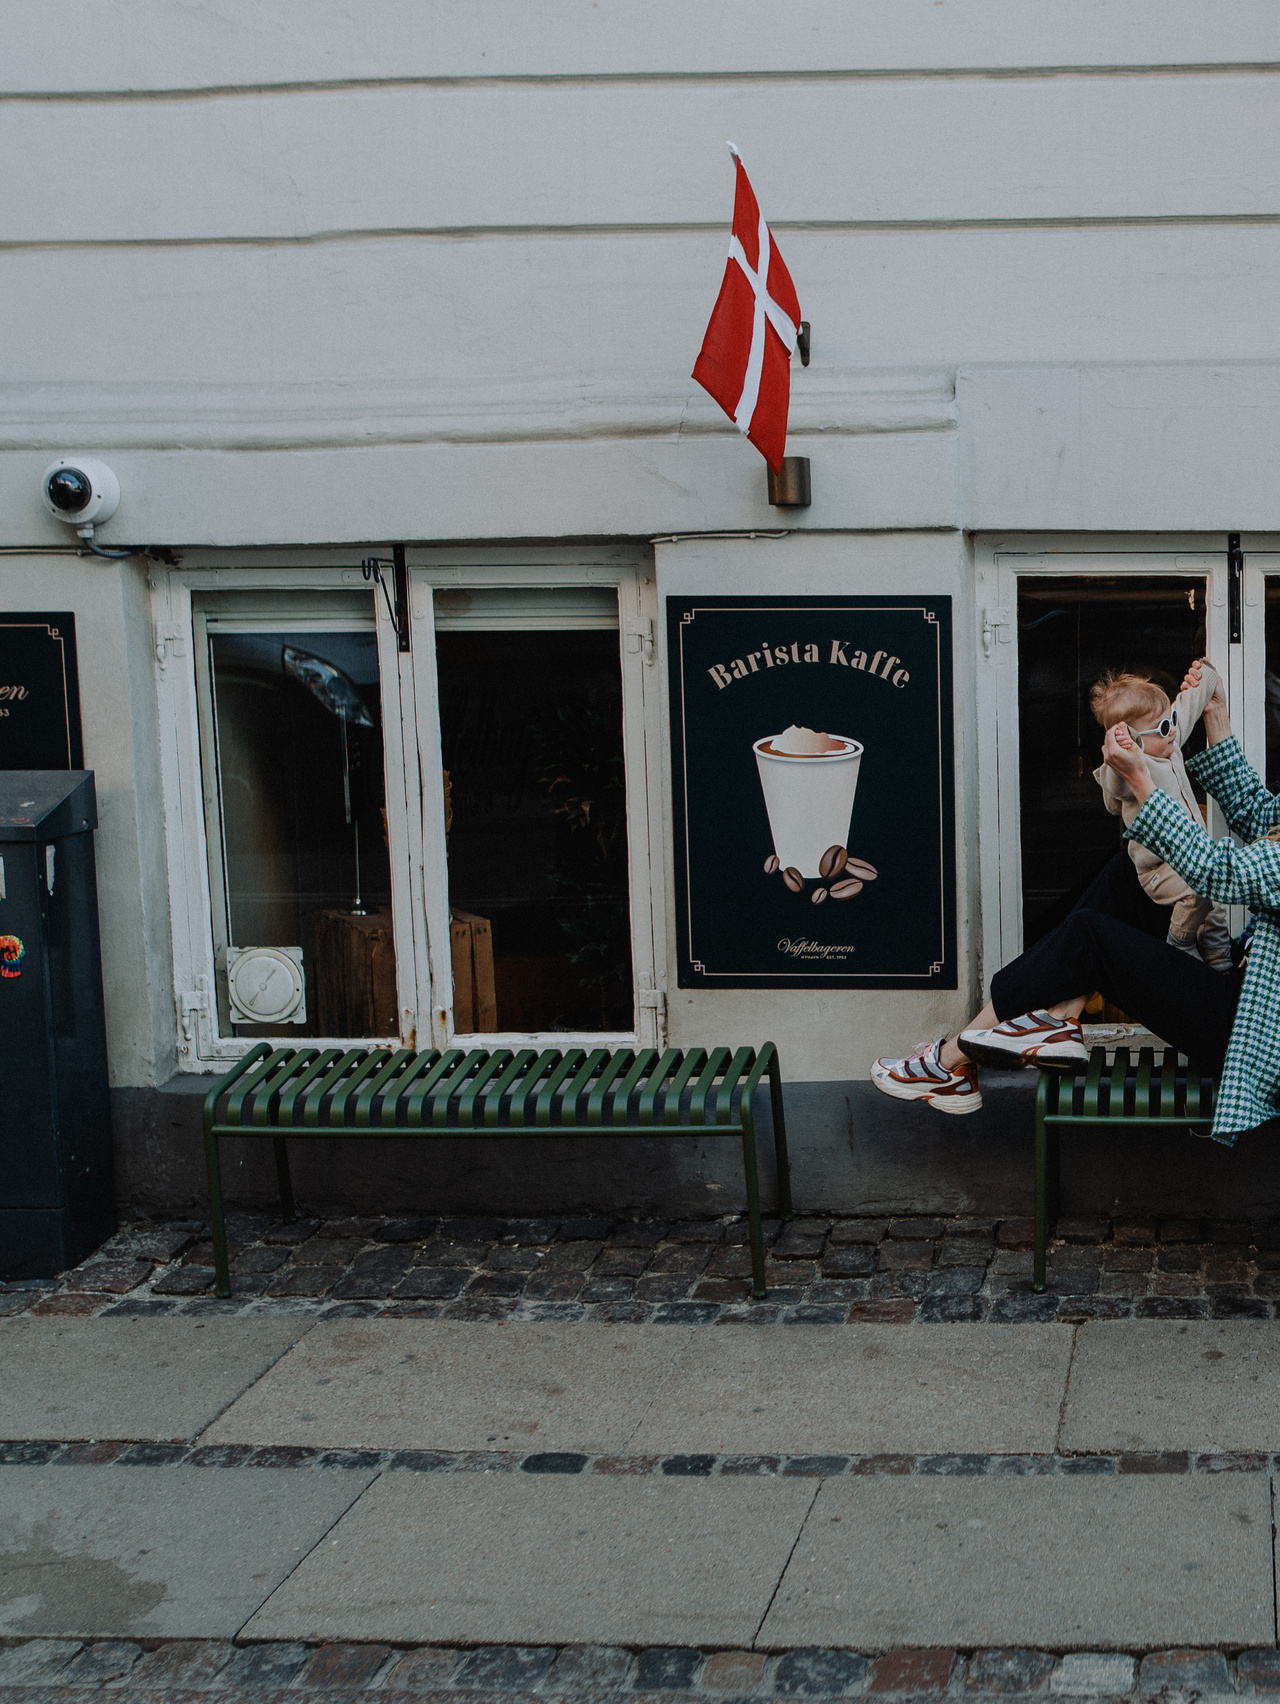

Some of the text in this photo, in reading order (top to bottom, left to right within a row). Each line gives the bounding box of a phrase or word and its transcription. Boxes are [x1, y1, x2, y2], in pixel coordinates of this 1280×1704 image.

[706, 639, 910, 691] Barista Kaffe
[777, 936, 856, 958] Vaffelbageren
